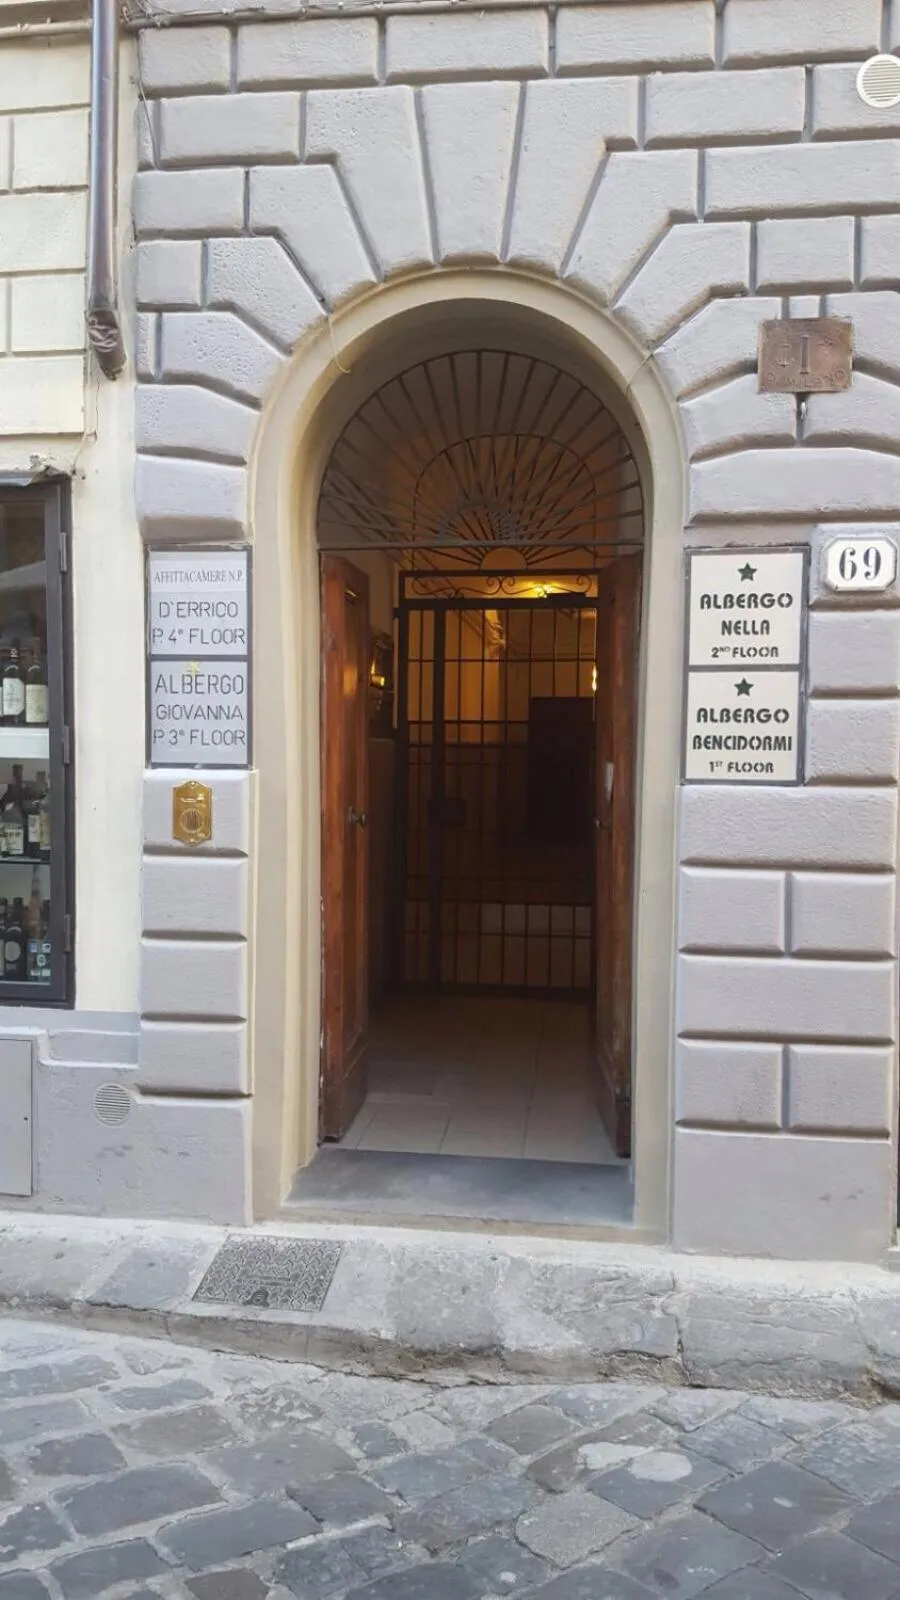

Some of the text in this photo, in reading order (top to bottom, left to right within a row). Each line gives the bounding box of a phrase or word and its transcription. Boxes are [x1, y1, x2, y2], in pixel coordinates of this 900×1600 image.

[839, 547, 882, 581] 69
[154, 570, 227, 584] AFFITTACAMERE
[699, 592, 793, 610] ALBERGO
[721, 619, 770, 636] NELLA
[189, 628, 246, 645] FLOOR
[732, 646, 779, 658] FLOOR
[155, 673, 244, 695] ALBERGO
[156, 703, 244, 720] GIOVANNA
[696, 707, 790, 724] ALBERGO
[190, 729, 246, 746] FLOOR
[692, 734, 792, 751] BENCIDORMI
[727, 761, 774, 773] FLOOR
